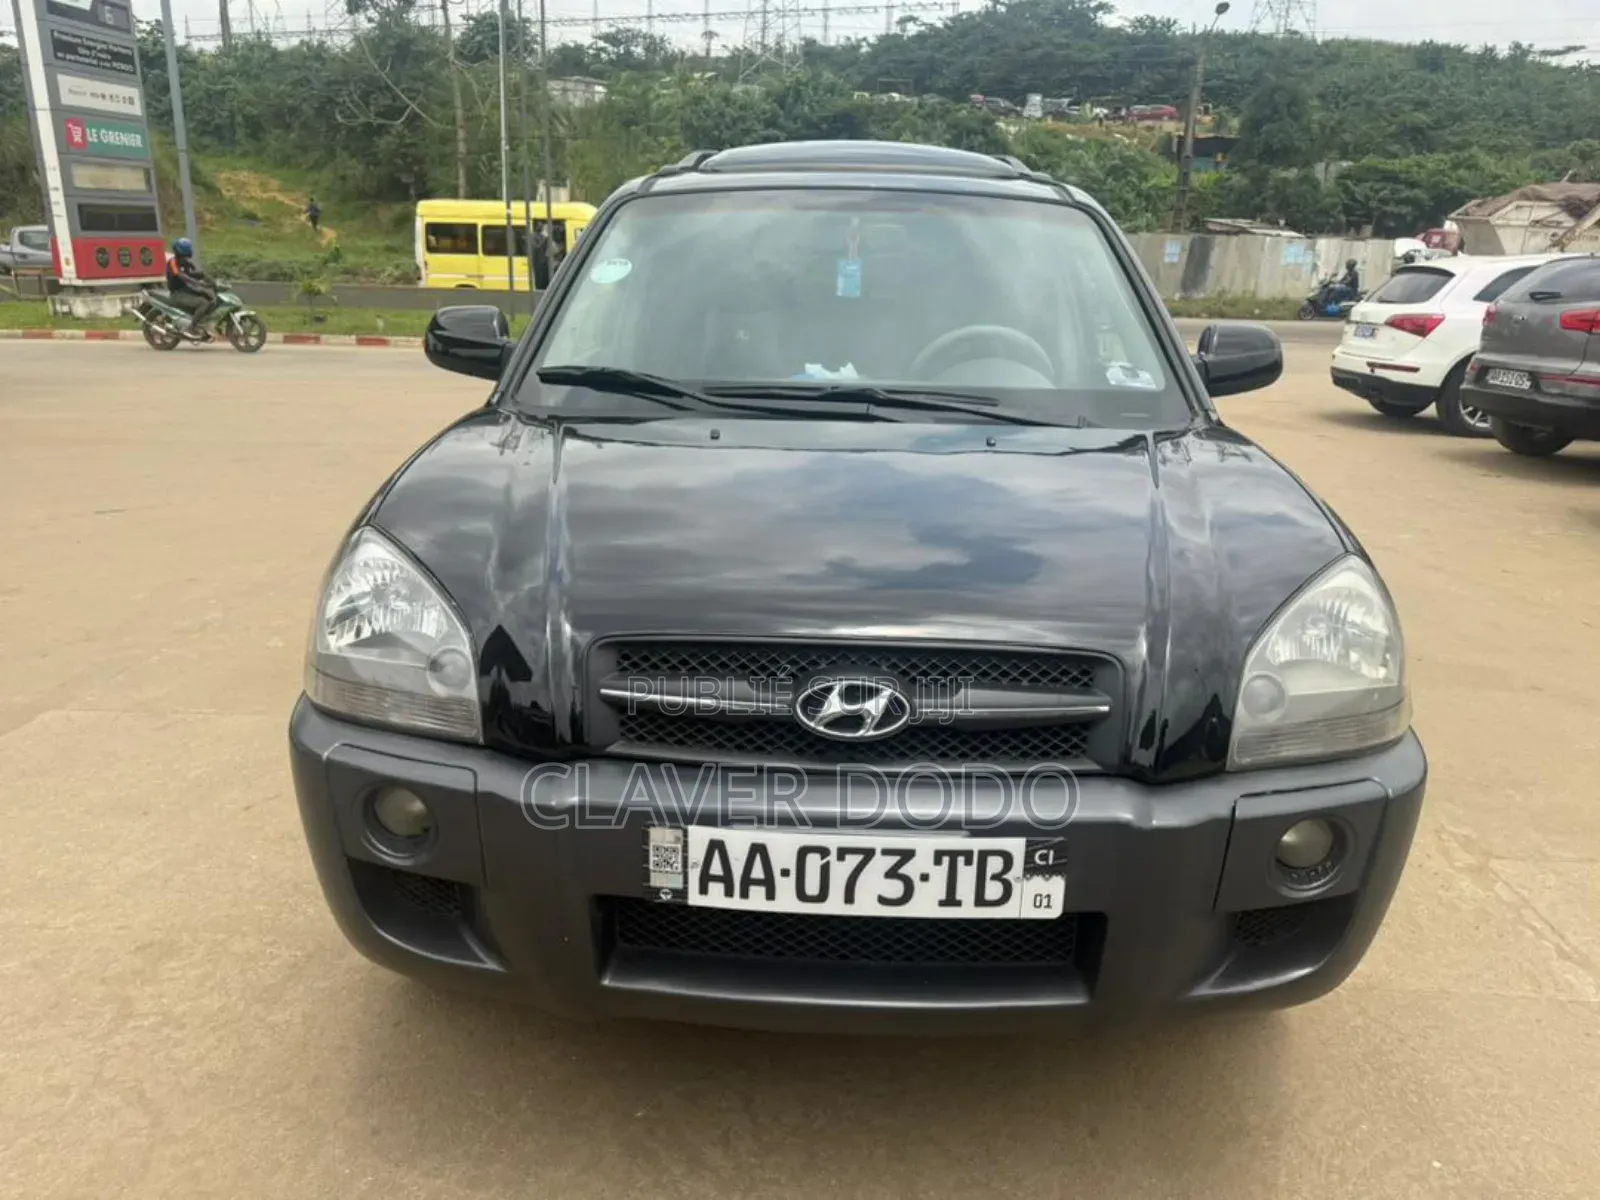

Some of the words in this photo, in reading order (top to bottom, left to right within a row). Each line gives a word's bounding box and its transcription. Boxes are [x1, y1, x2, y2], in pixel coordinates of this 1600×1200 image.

[86, 127, 99, 143] LE
[100, 128, 144, 149] GRENIER
[1034, 849, 1055, 866] CI
[1033, 892, 1053, 910] 01
